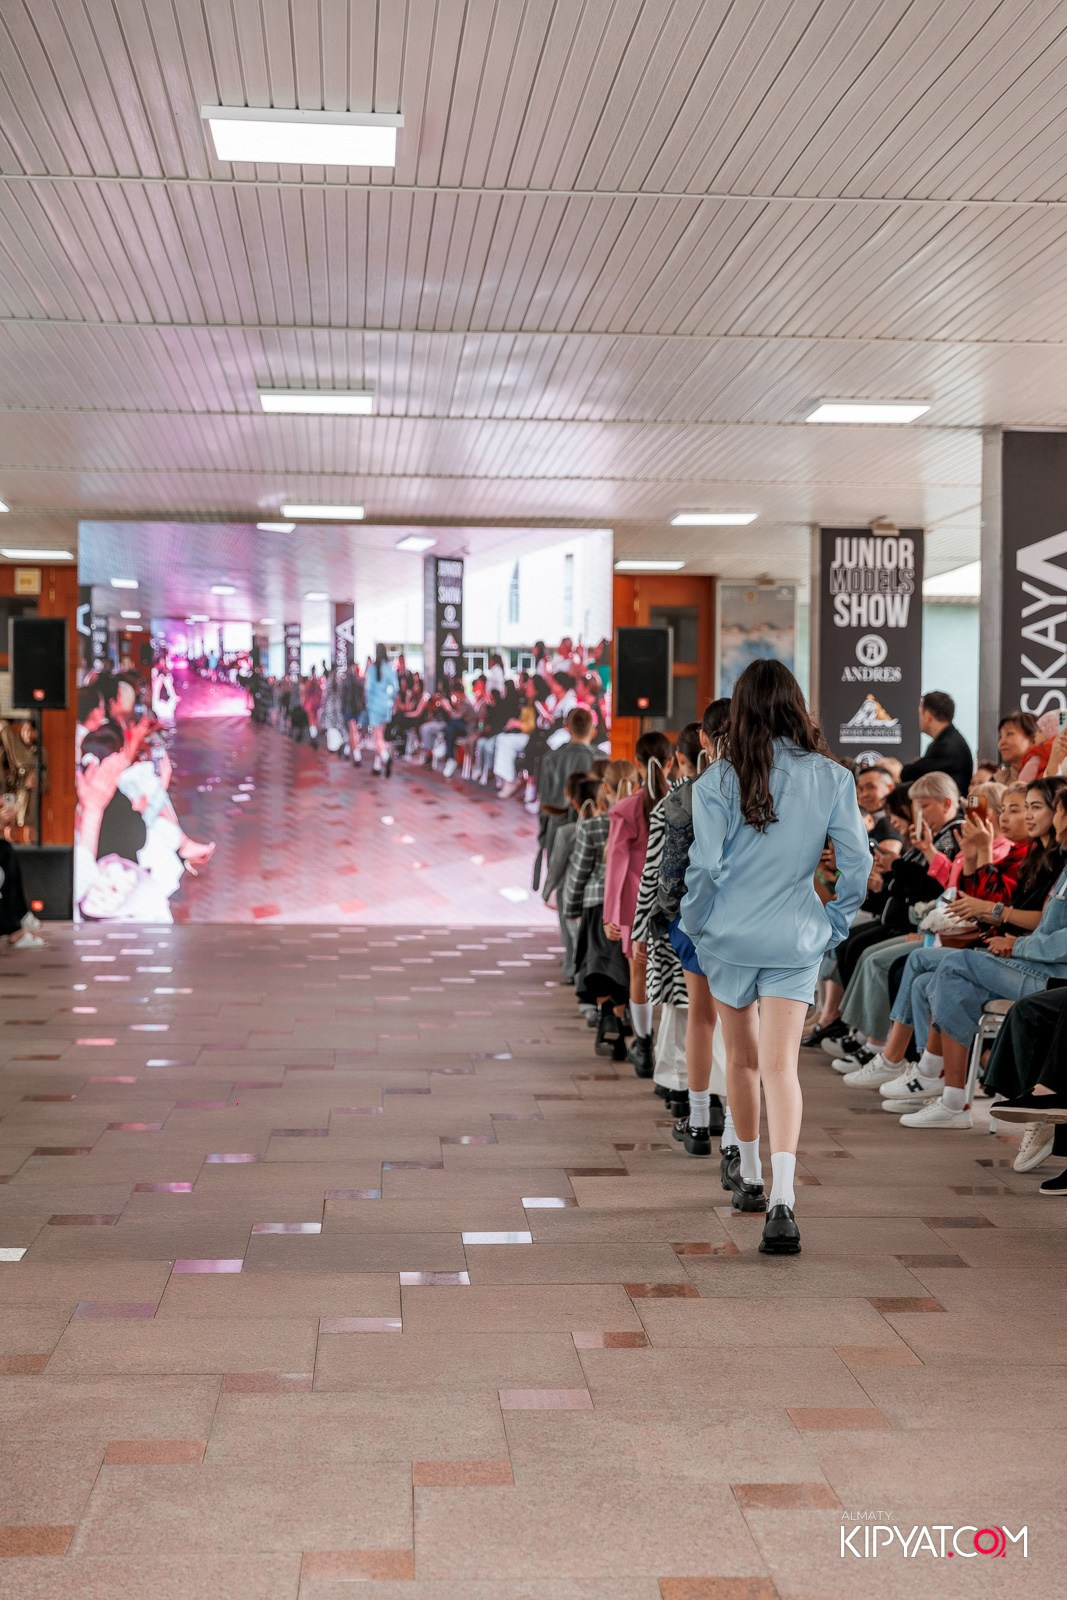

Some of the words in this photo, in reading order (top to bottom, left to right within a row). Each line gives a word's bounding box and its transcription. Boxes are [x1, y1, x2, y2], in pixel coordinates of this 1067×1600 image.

[830, 537, 914, 569] JUNIOR
[829, 567, 915, 595] MODELS
[833, 593, 910, 628] SHOW
[841, 666, 902, 682] ANDRES
